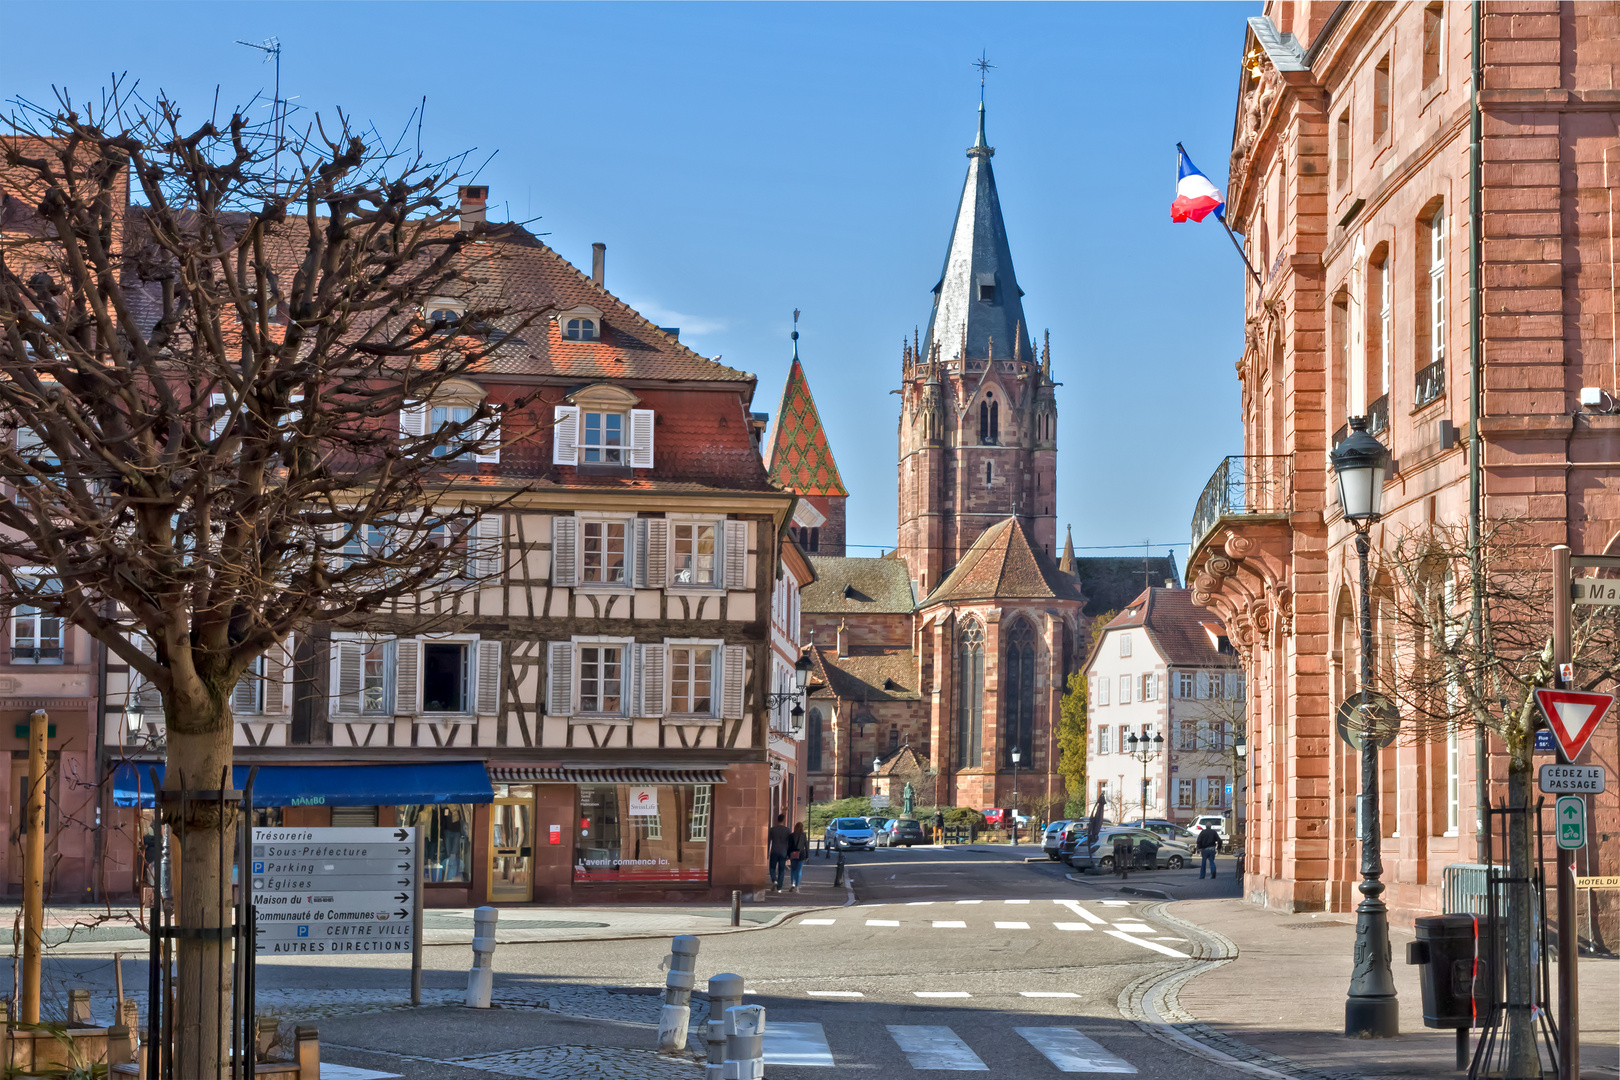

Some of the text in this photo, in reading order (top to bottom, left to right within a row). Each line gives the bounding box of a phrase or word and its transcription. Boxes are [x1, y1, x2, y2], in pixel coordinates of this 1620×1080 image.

[1589, 584, 1620, 599] Ma
[1548, 767, 1599, 778] CÉDEZ LE
[1549, 780, 1597, 789] PASSAGE
[291, 796, 326, 806] MAMBO
[255, 830, 313, 840] Trésorerie
[268, 846, 368, 857] Sous-Préfecture
[578, 858, 612, 866] L'avenir
[254, 862, 314, 875] P Parking
[267, 877, 312, 890] Églises
[1578, 878, 1604, 886] HOTEL
[254, 894, 288, 904] Maison
[290, 895, 302, 904] du
[255, 909, 375, 921] Communauté de Communes
[298, 925, 410, 937] P CENTRE VILLE
[274, 941, 410, 952] AUTRES DIRECTIONS
